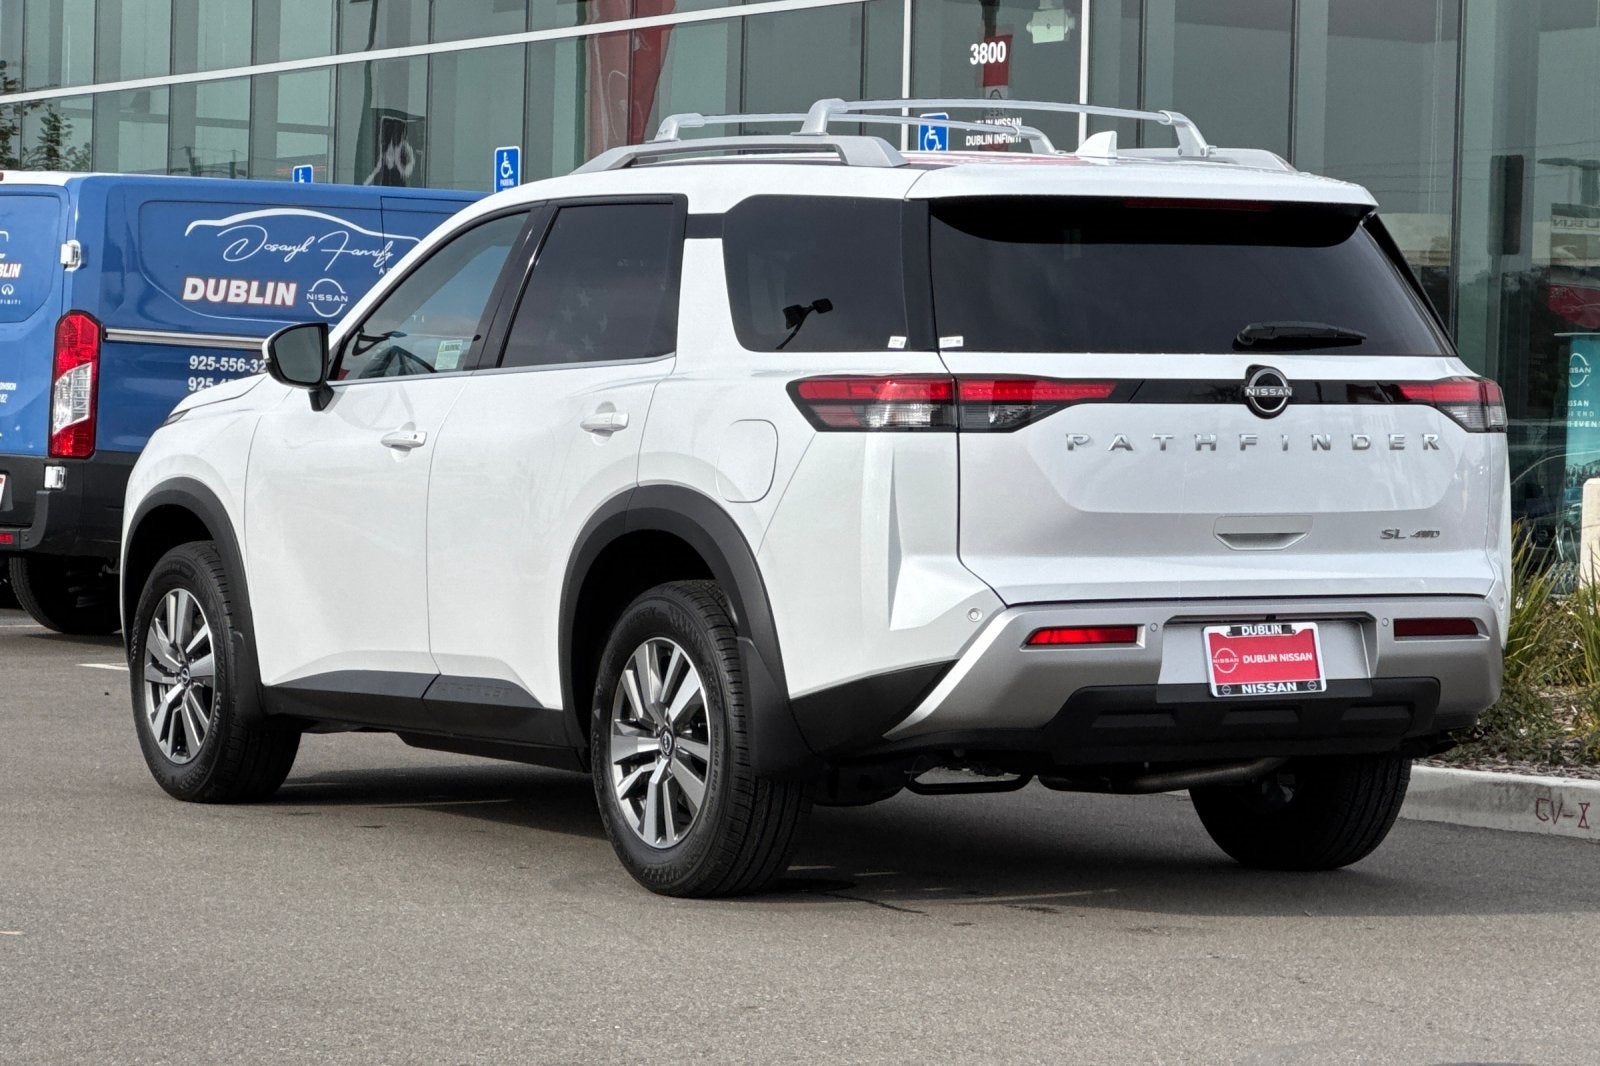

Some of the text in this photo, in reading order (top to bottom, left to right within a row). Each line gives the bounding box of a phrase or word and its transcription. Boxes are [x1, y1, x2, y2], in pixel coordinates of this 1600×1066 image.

[970, 41, 1007, 65] 3800
[966, 134, 993, 147] DUBLIN
[318, 230, 394, 272] Family
[0, 263, 22, 278] BLIN
[182, 276, 298, 307] DUBLIN
[306, 292, 349, 303] NISSAN
[189, 354, 267, 374] 925-556-32
[1245, 387, 1293, 397] NISSAN
[1065, 432, 1441, 452] PATHFINDER
[1380, 528, 1407, 540] SL
[1241, 624, 1282, 636] DUBLIN
[1212, 652, 1313, 665] NISSAN DUBLIN NISSAN
[1241, 681, 1298, 695] NISSAN
